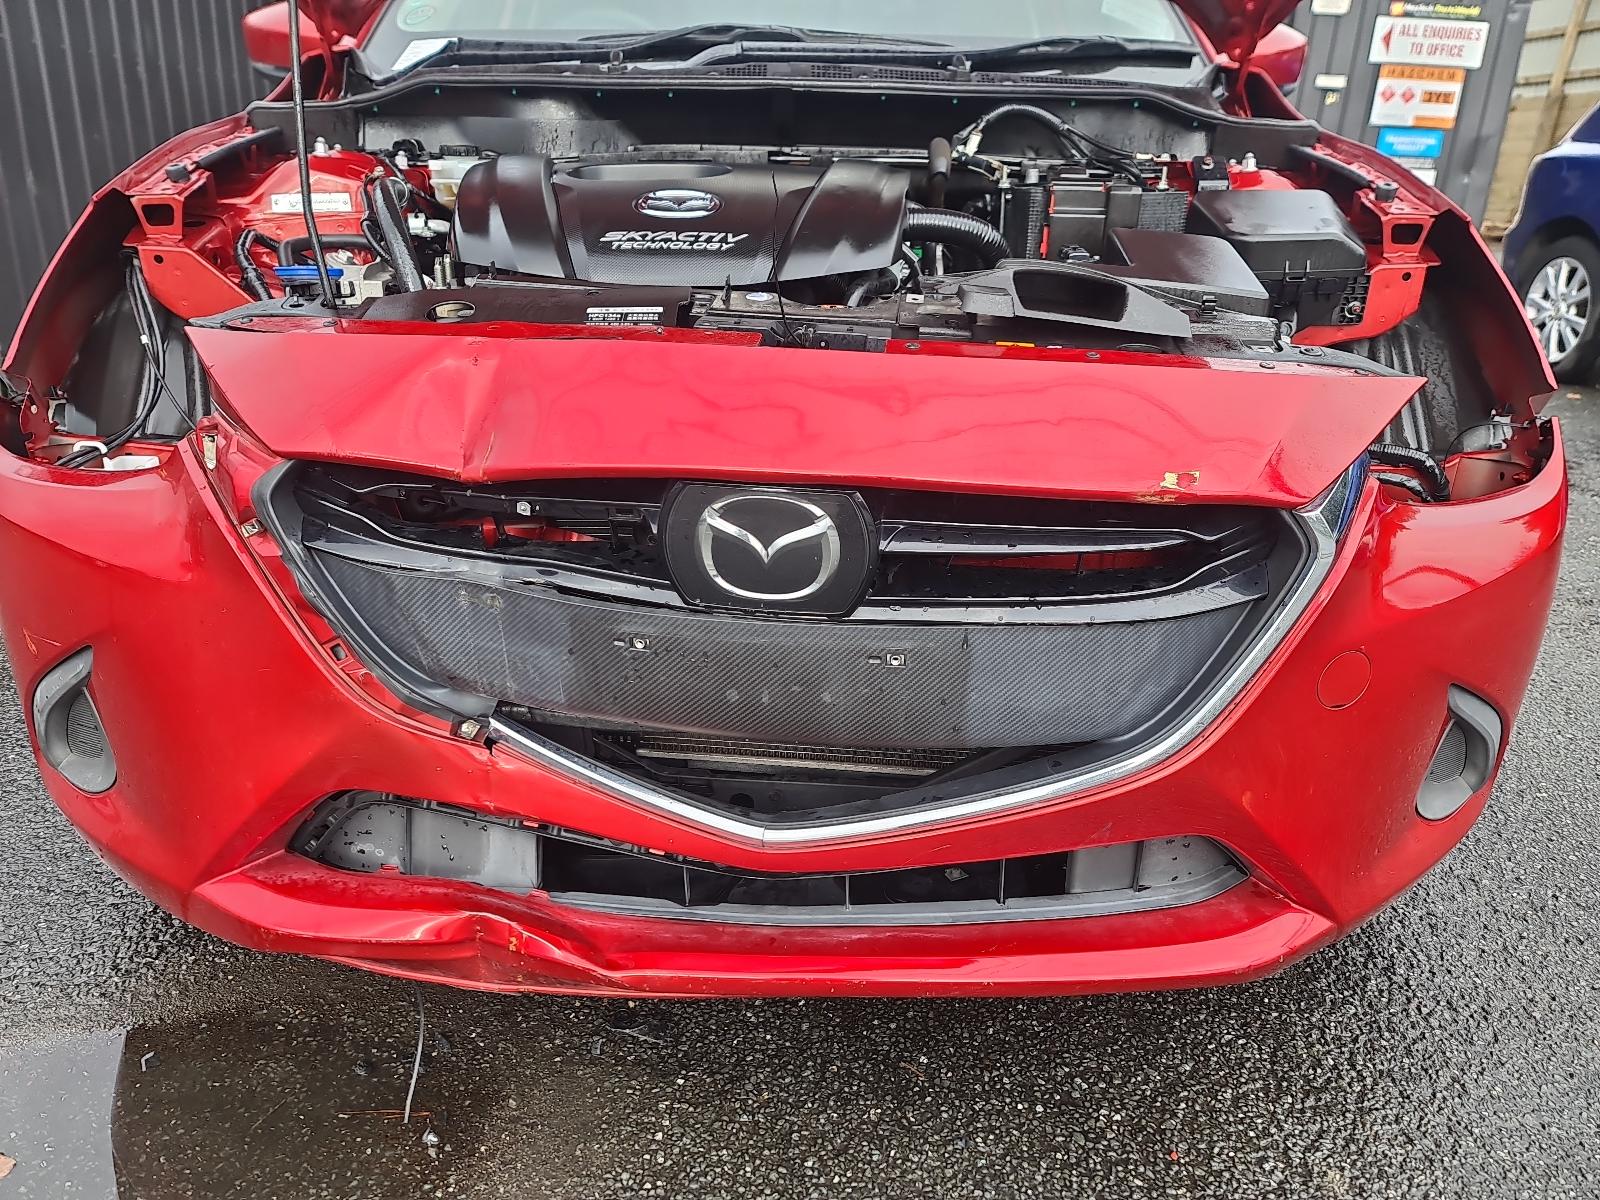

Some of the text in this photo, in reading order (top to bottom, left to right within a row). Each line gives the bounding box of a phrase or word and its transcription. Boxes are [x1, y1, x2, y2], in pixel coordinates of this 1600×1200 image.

[1399, 24, 1482, 40] ALL ENQUIRIES
[1409, 42, 1465, 57] TO OFFICE
[600, 231, 749, 243] SKYACTIV
[611, 241, 735, 251] TECHNOLOGY
